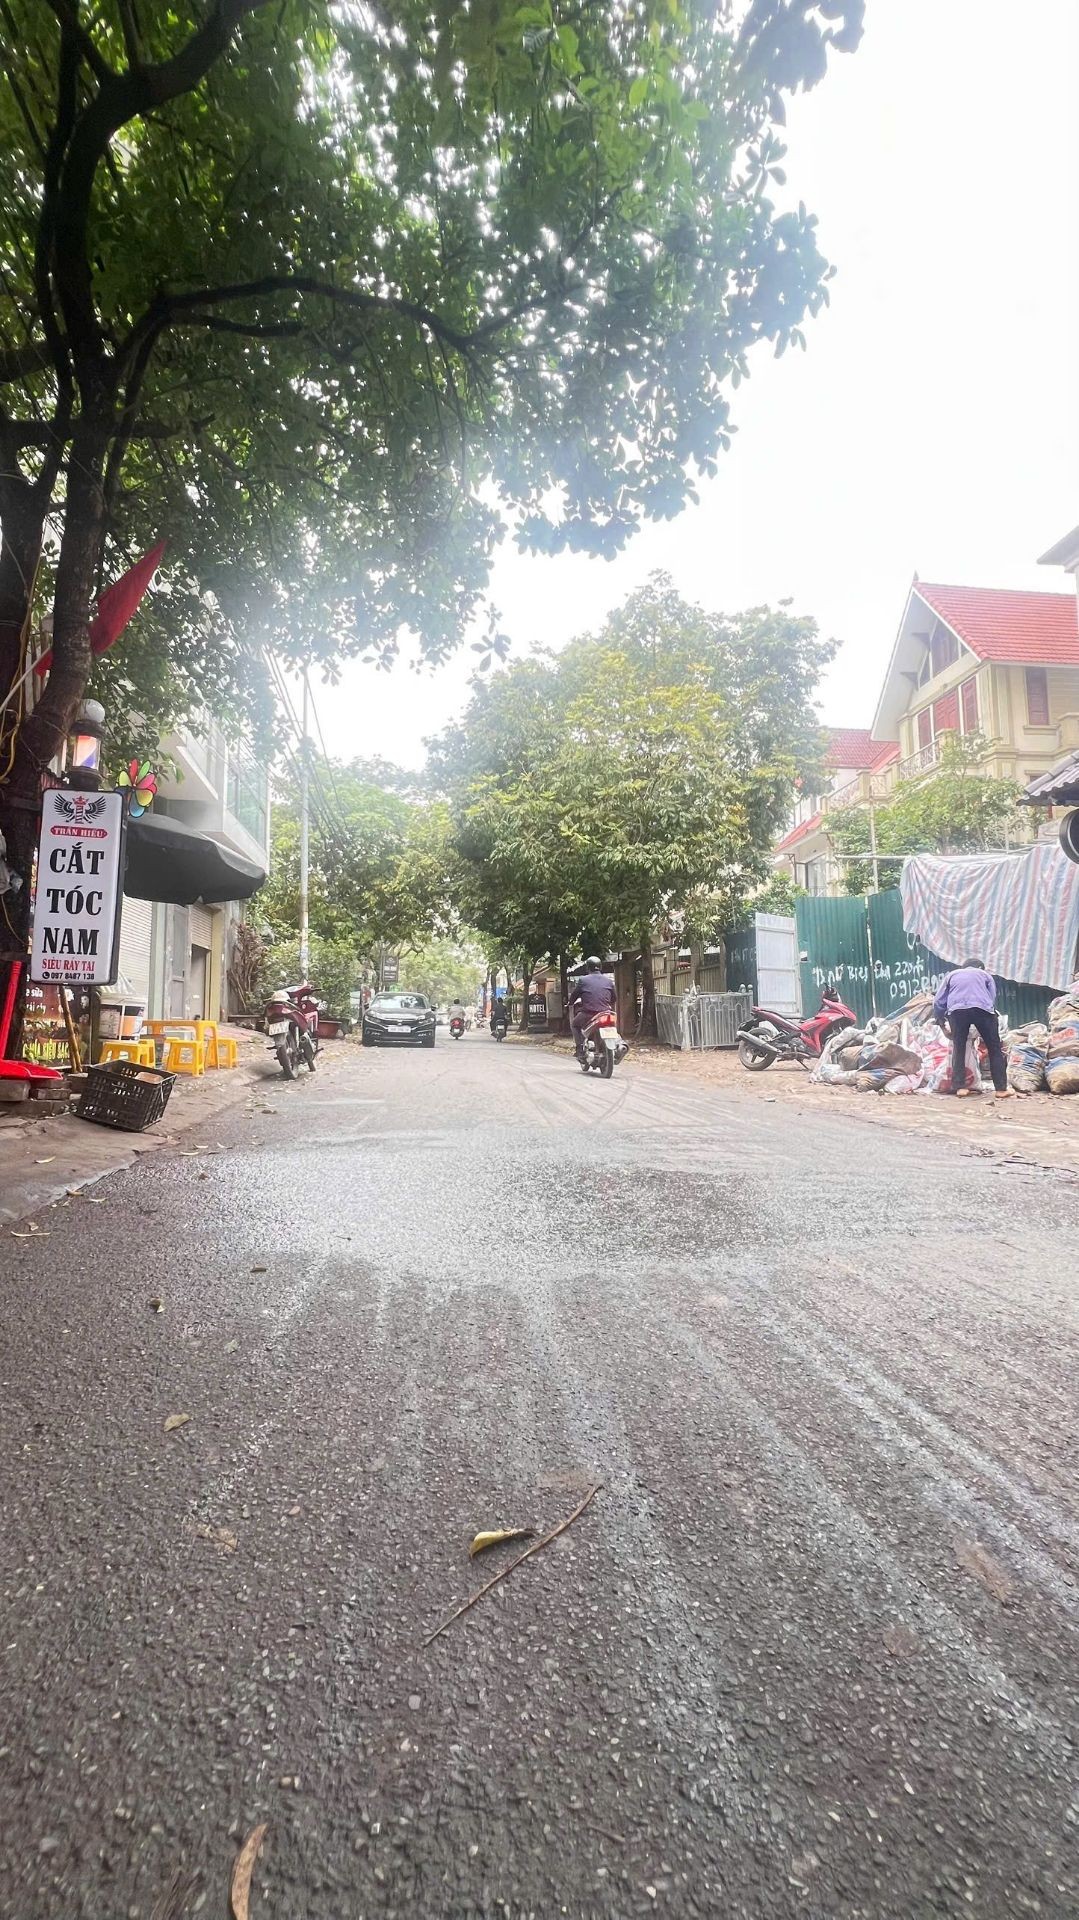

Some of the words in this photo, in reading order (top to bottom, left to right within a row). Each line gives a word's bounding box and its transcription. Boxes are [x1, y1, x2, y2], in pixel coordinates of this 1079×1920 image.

[50, 842, 104, 875] CẮT
[46, 885, 103, 916] TÓC
[42, 927, 100, 956] NAM
[82, 961, 95, 972] TAI
